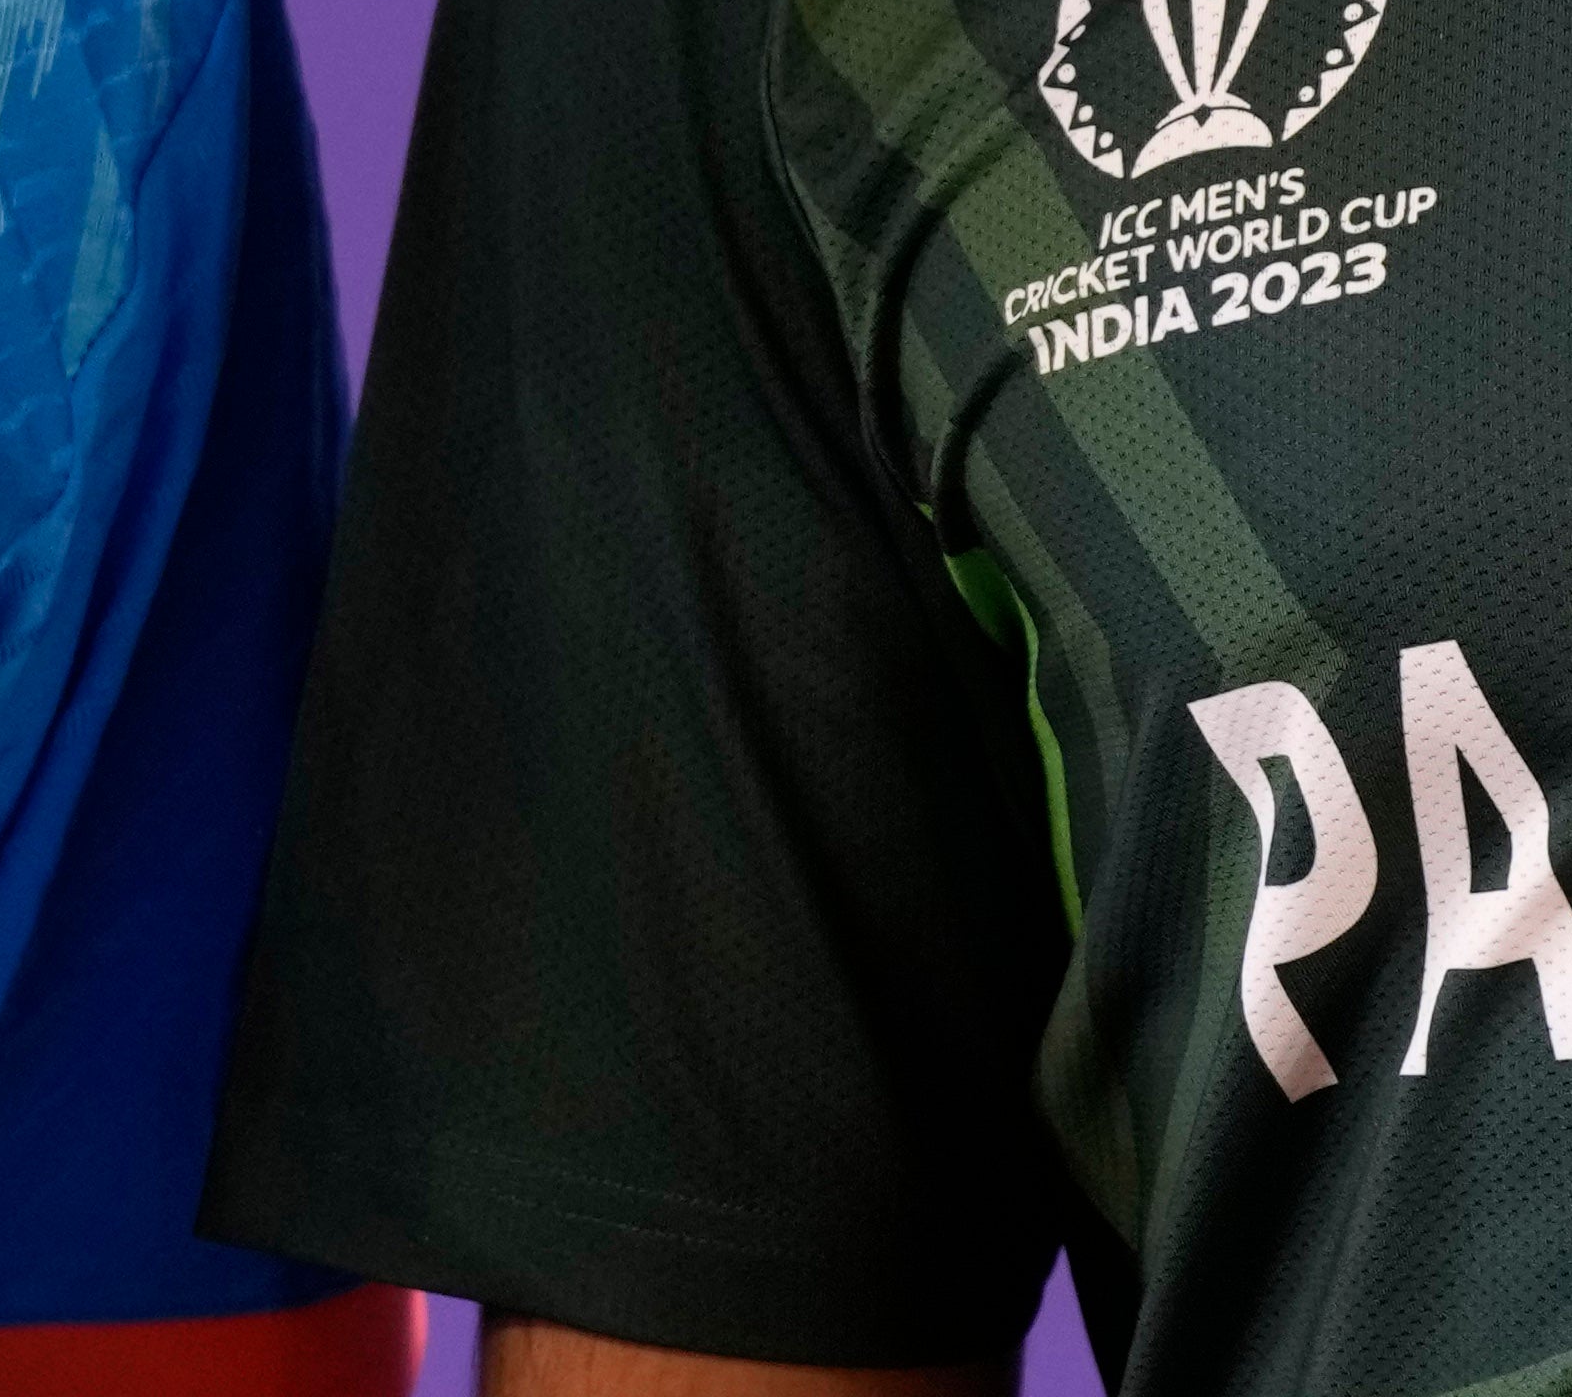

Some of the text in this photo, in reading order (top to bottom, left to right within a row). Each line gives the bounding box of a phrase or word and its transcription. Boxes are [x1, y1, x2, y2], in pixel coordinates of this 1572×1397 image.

[1004, 186, 1438, 325] CRICKET WORLD CUP
[1101, 167, 1307, 250] ICC MEN'S
[1029, 243, 1388, 375] INDIA 2023
